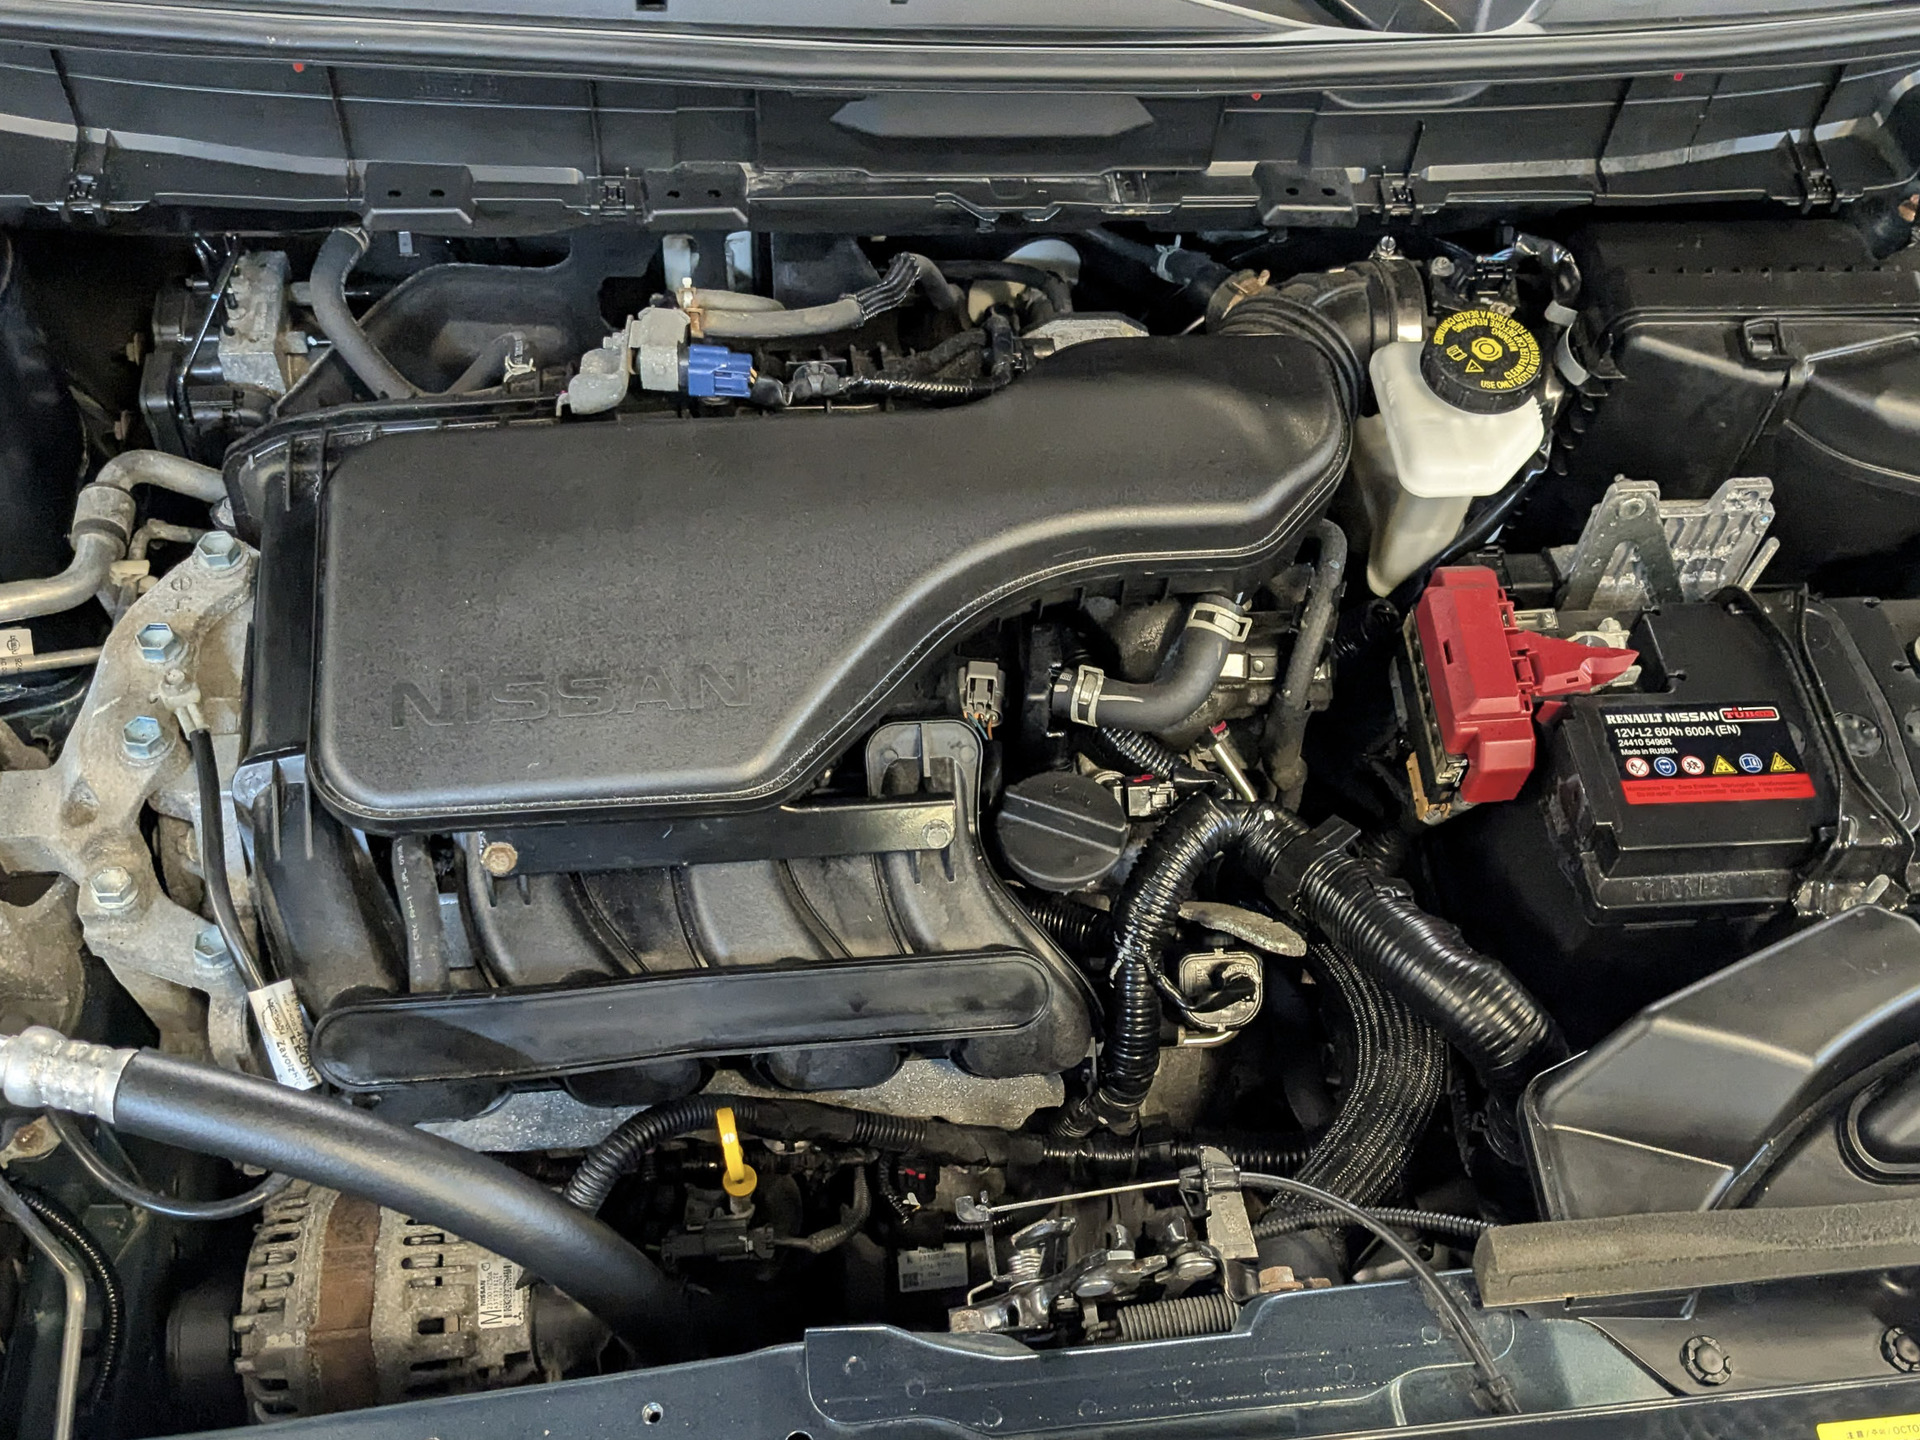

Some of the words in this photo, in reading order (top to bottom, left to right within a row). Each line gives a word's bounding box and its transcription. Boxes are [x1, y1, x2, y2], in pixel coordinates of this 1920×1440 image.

[1453, 310, 1480, 322] SEALED
[1480, 310, 1487, 319] A
[1486, 311, 1509, 324] FROM
[1489, 319, 1518, 338] BEFORE
[1507, 319, 1528, 335] FLUID
[1491, 327, 1519, 352] WARNING
[1513, 336, 1528, 348] CAP
[1503, 363, 1526, 380] CLEAN
[1480, 379, 1496, 389] USE
[1496, 379, 1516, 389] ONLY
[390, 662, 751, 730] NISSAN
[1605, 713, 1663, 725] RENAULT
[1665, 711, 1719, 723] NISSAN
[1614, 727, 1653, 738] 12V-L2
[1654, 726, 1684, 737] 60Ah
[1684, 725, 1715, 736] 600A
[1715, 723, 1742, 737] (EN)
[1618, 739, 1645, 747] 24410
[1620, 748, 1641, 756] Made
[1648, 747, 1679, 755] RUSSIA
[480, 1309, 502, 1325] M
